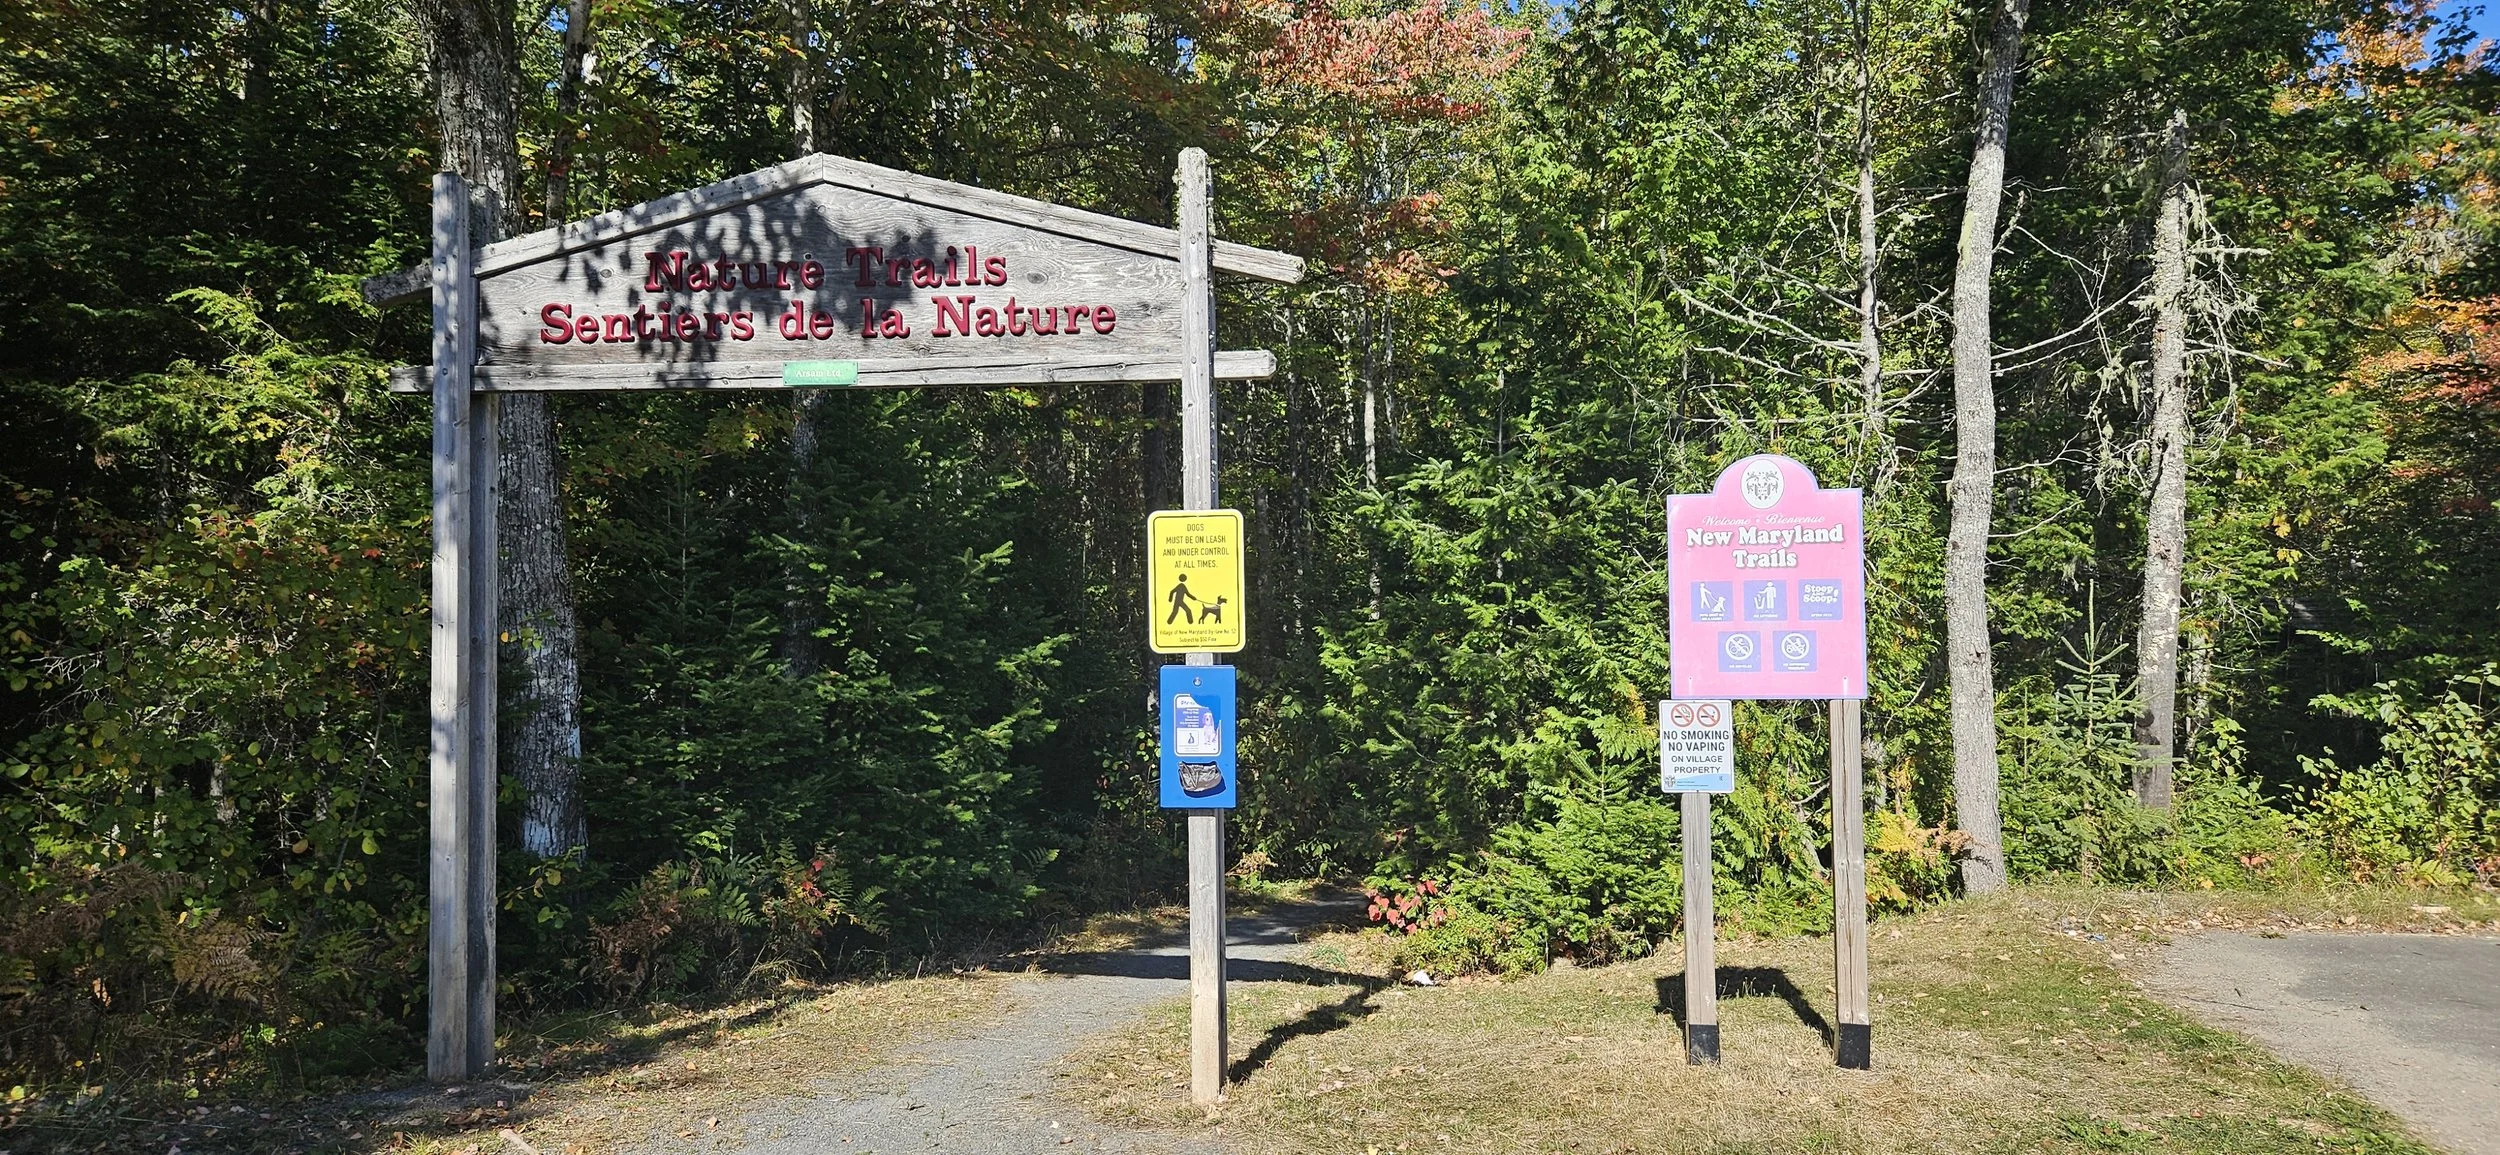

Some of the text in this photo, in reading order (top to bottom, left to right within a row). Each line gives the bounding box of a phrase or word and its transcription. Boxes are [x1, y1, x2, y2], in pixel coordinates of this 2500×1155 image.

[644, 246, 1008, 292] Nature Trails
[540, 296, 1117, 344] Sentiers de la Nature
[1702, 513, 1825, 526] Welcome Bienvenue
[1186, 523, 1205, 532] DOGS
[1166, 536, 1183, 544] MUST
[1206, 535, 1226, 543] LEASH
[1686, 524, 1844, 548] New Maryland
[1163, 547, 1229, 556] AND UNDER CONTROL
[1175, 559, 1218, 568] AT ALL TIMES.
[1732, 549, 1797, 568] Trails
[1804, 584, 1834, 594] Stoop
[1663, 730, 1729, 740] NO SMOKING
[1668, 742, 1725, 752] NO VAPING
[1671, 755, 1723, 763] ON VILLAGE
